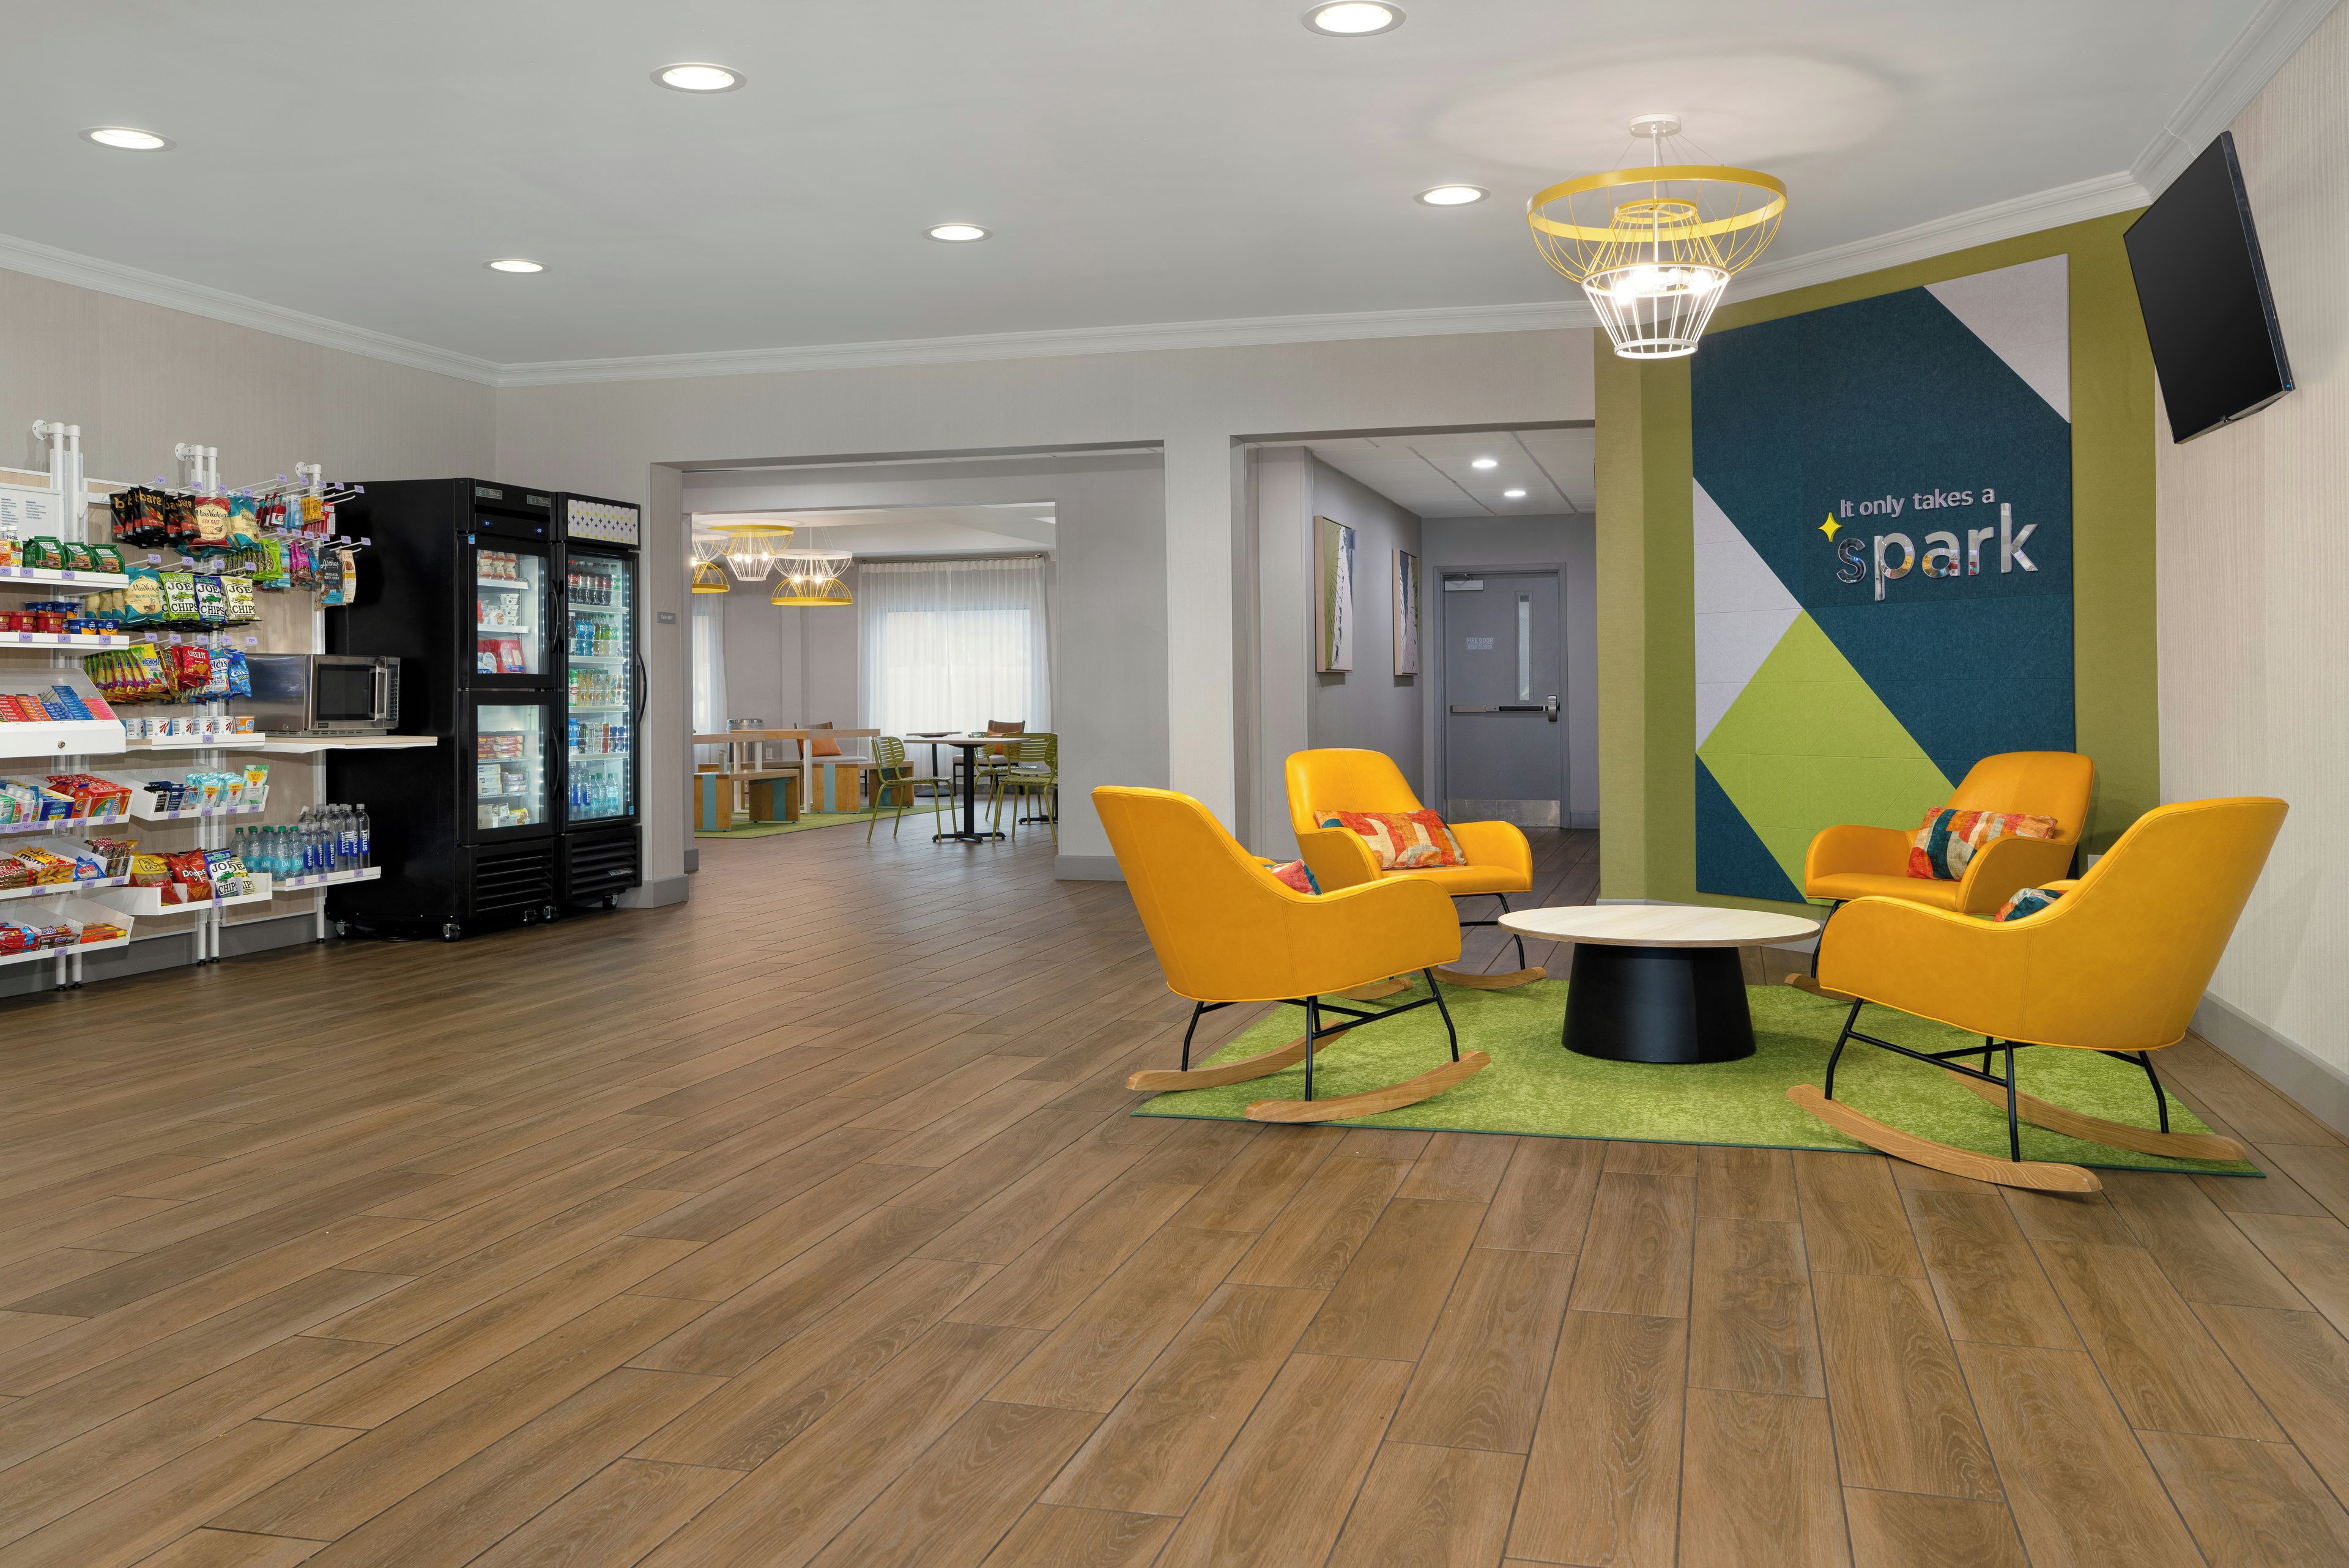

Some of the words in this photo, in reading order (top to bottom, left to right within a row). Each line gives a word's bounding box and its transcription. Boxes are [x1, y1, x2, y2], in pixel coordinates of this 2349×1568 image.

[138, 489, 162, 506] bare
[1840, 499, 1854, 518] It
[1859, 495, 1905, 518] only
[1912, 489, 1973, 511] takes
[1981, 488, 1996, 503] a
[1836, 503, 2039, 601] spark
[168, 582, 193, 591] JOE
[198, 584, 220, 594] JOE
[229, 585, 253, 594] JOE
[171, 602, 198, 612] CHIPS
[200, 605, 225, 615] CHIPS
[210, 659, 228, 670] elch's
